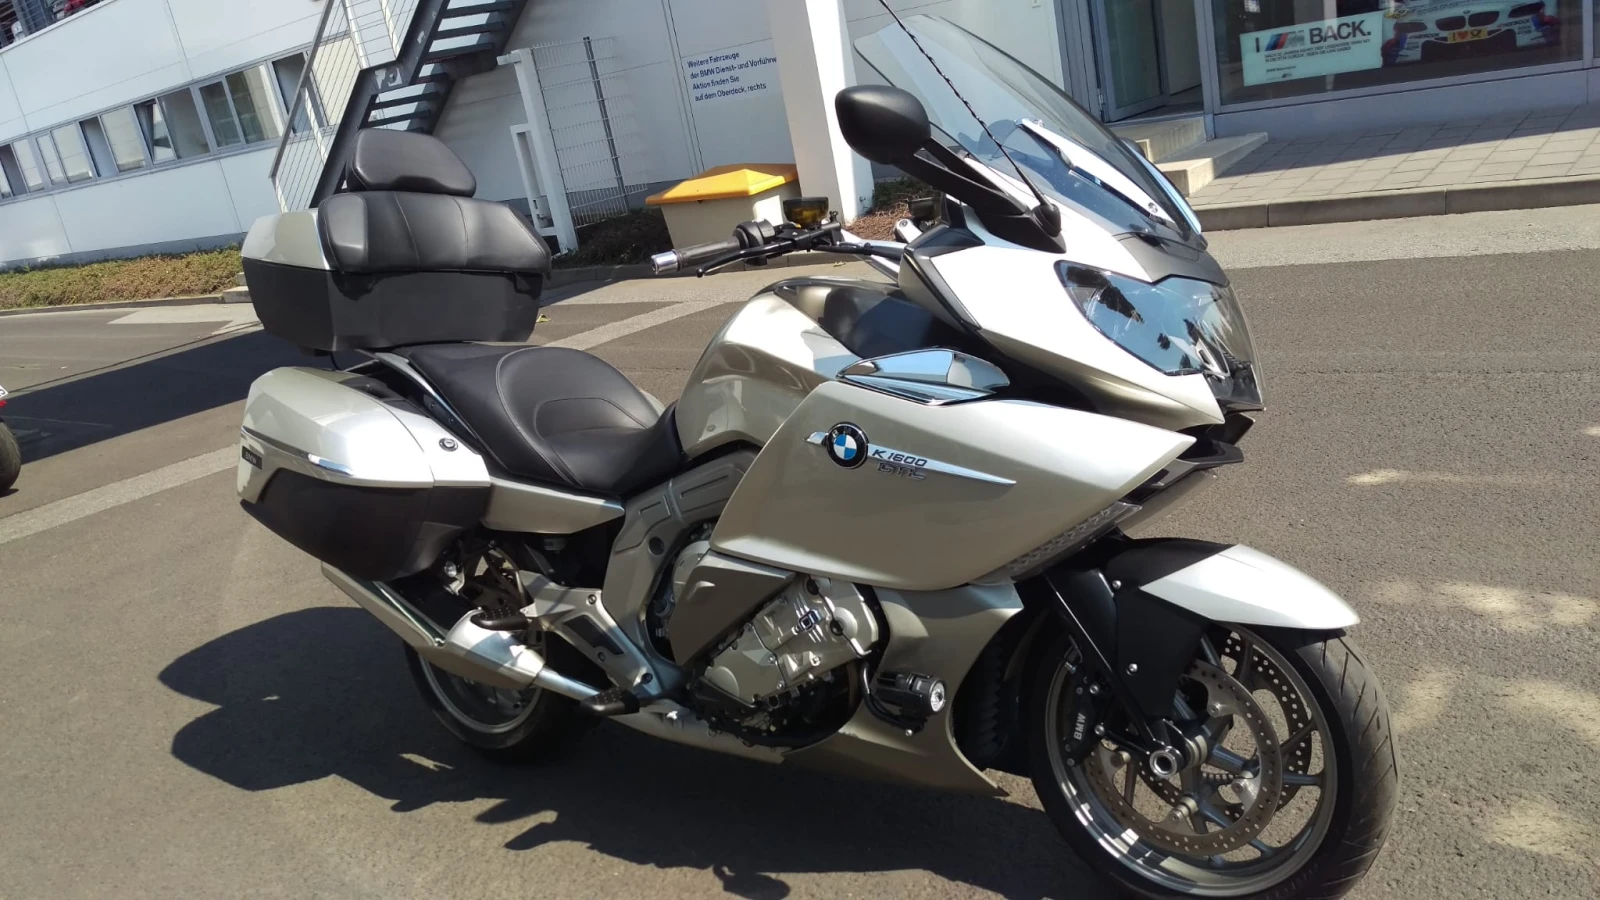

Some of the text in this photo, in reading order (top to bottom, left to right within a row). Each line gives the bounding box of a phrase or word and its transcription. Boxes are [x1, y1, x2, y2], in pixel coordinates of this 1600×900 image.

[1309, 20, 1372, 45] BACK.
[687, 53, 739, 68] Weitere Fahrzeuge
[700, 68, 715, 77] BMW
[716, 65, 737, 74] Dienst-
[738, 61, 749, 69] und
[693, 82, 711, 90] Aktion
[711, 78, 729, 87] finden
[747, 82, 767, 92] rechts
[872, 449, 928, 467] K 1600
[1074, 713, 1085, 740] BMW
